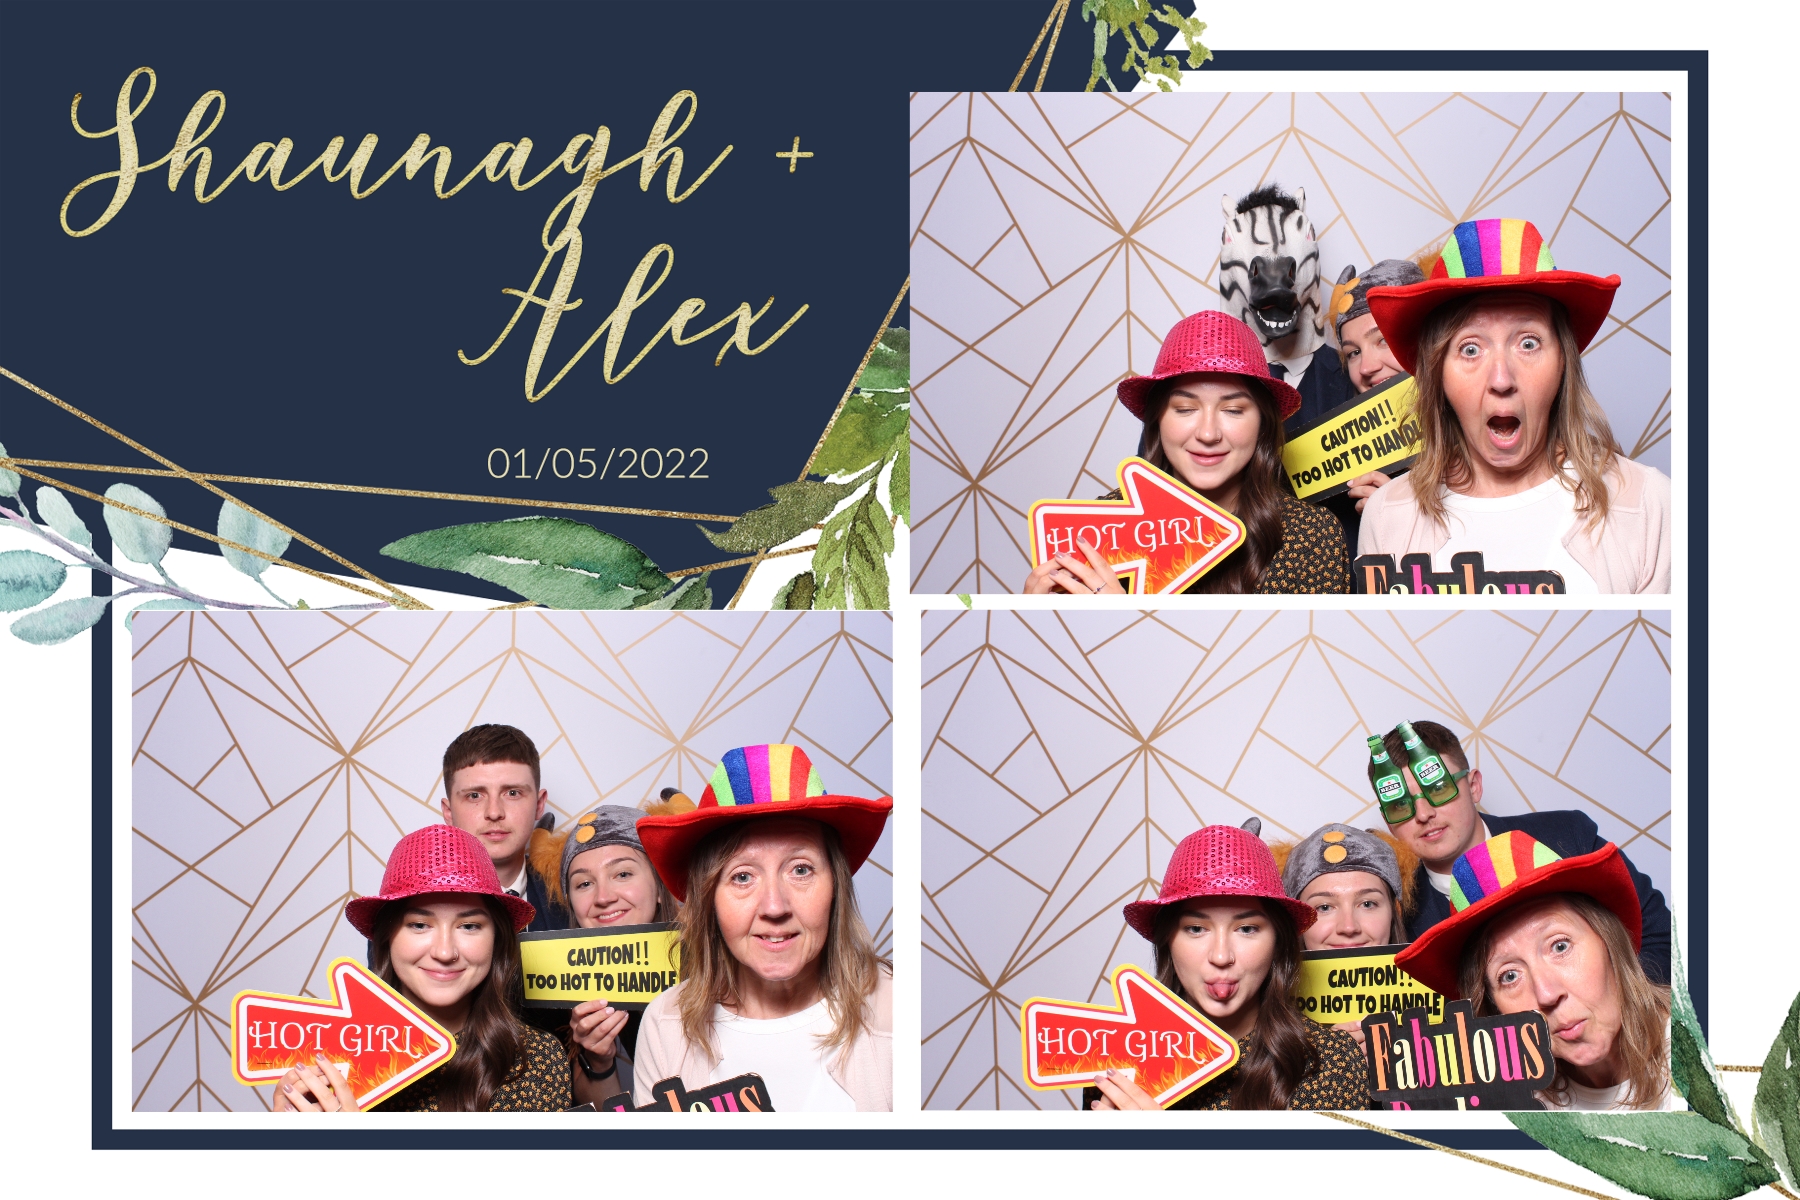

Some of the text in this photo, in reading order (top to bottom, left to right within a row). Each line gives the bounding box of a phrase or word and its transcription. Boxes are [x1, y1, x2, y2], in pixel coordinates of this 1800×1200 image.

[1321, 399, 1397, 452] CAUTION!!
[1292, 419, 1425, 489] TOO HOT TO HANDL
[1046, 515, 1214, 556] HOT GIRL
[567, 940, 649, 967] CAUTION!!
[526, 970, 677, 994] TOO HOT TO HANDLE
[1289, 992, 1441, 1016] OO HOT TO HANDLE
[248, 1020, 425, 1059] HOT GIRL
[1037, 1026, 1209, 1064] HOT GIRL
[1369, 1011, 1545, 1092] Fabulous
